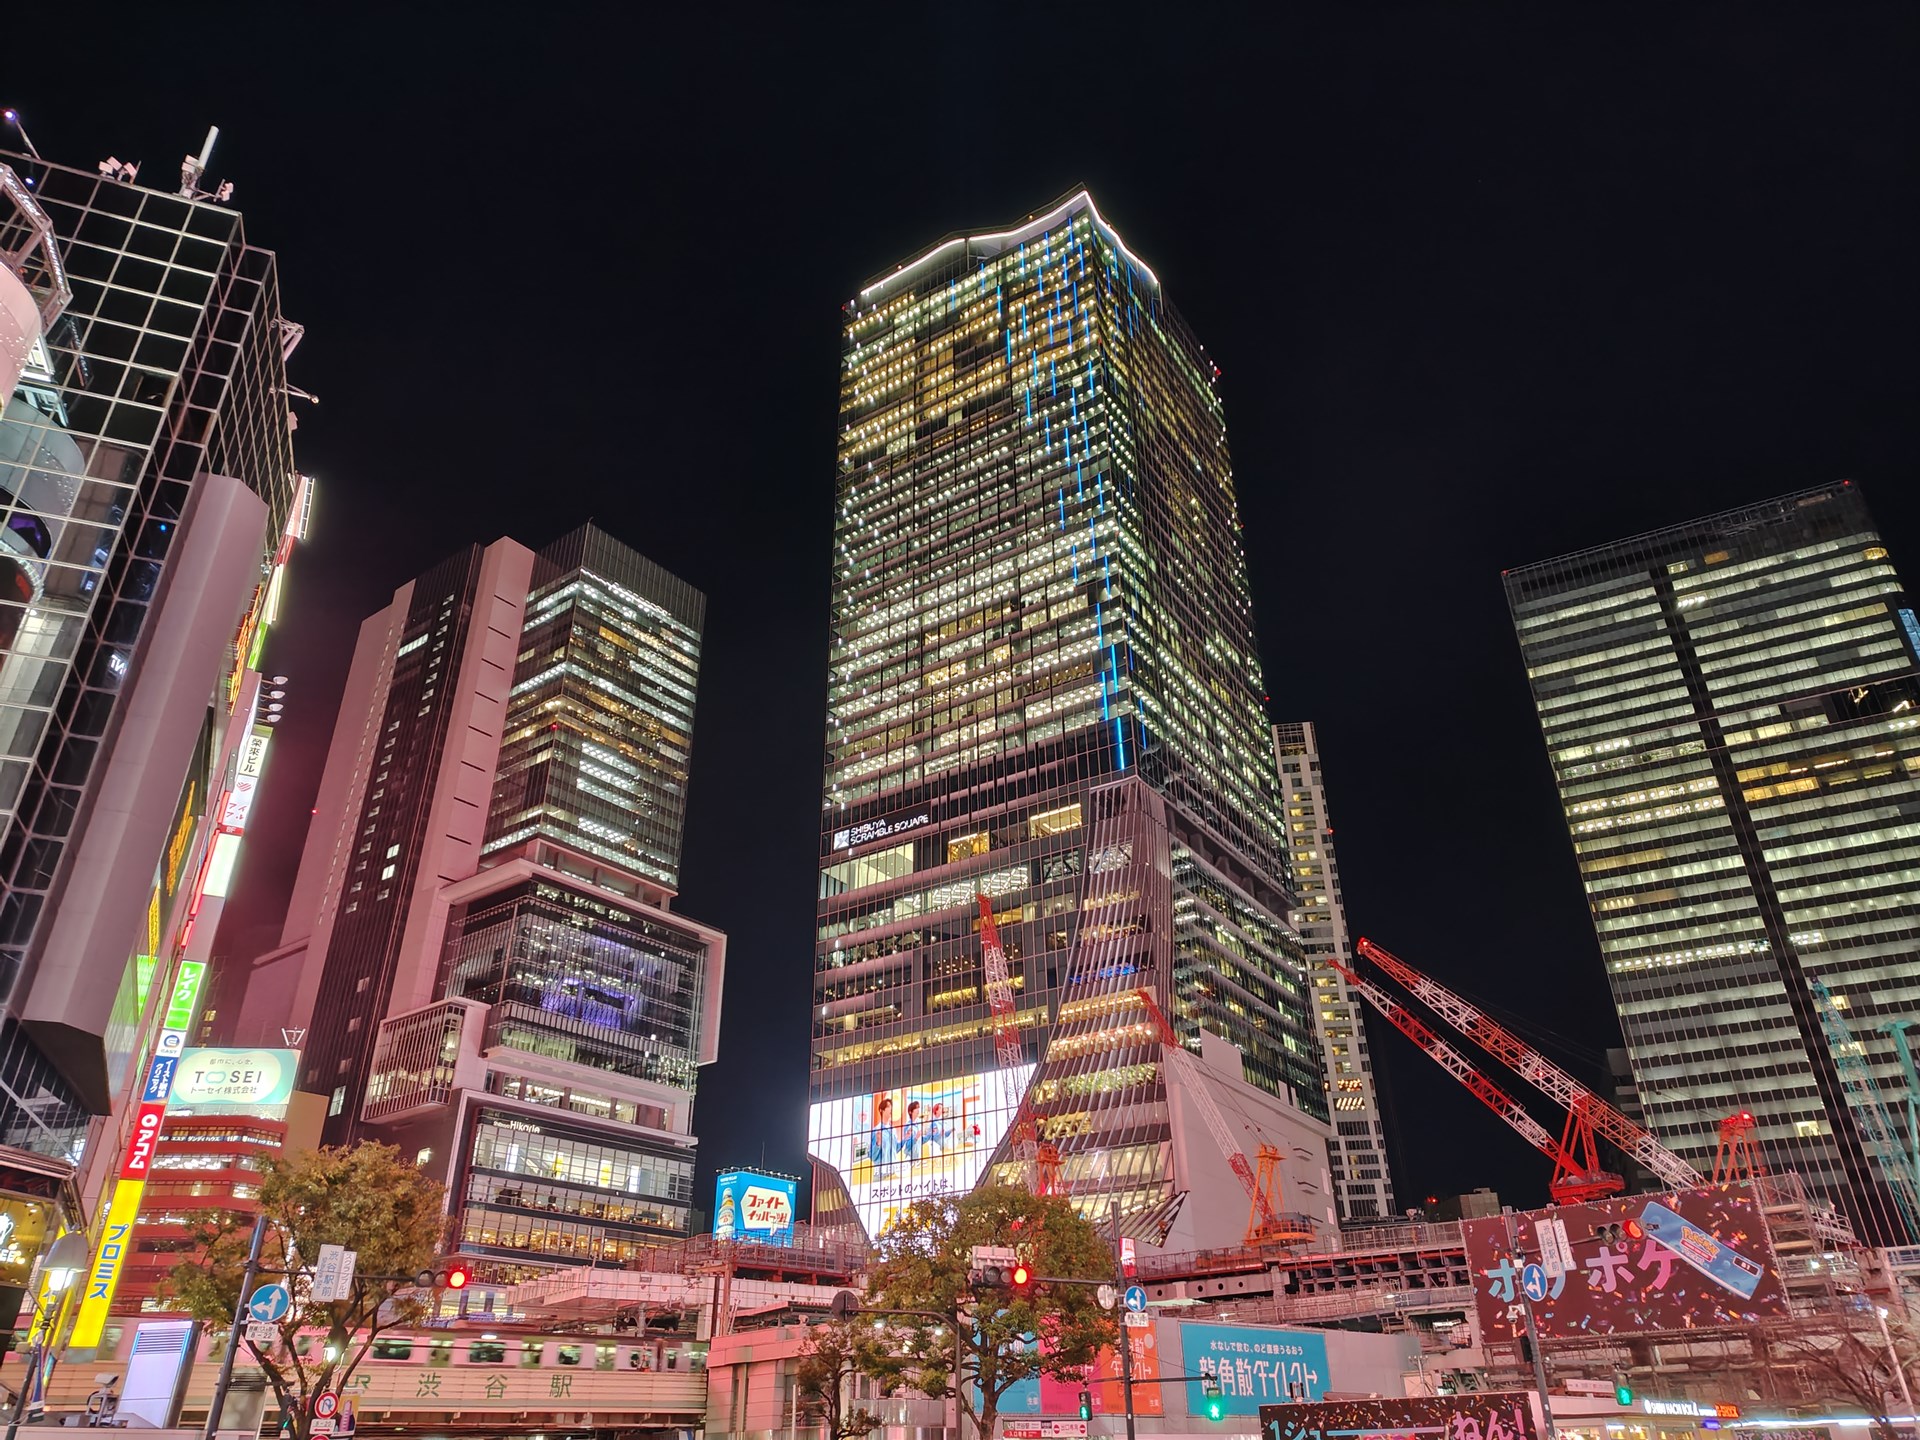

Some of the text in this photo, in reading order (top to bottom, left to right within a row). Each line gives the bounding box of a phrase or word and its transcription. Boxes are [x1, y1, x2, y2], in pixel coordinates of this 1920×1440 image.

[850, 818, 886, 837] SHIBUYA
[850, 814, 929, 845] SCRAMBLE SQUARE
[176, 966, 197, 1001] レイク
[128, 1128, 155, 1170] アコム
[747, 1193, 785, 1210] ファイト
[89, 1223, 130, 1299] プロミス
[321, 1250, 340, 1297] 渋谷駅前
[1209, 1339, 1304, 1356] 水なしで飲む、のど直接うるおう
[415, 1372, 573, 1399] 渋谷駅
